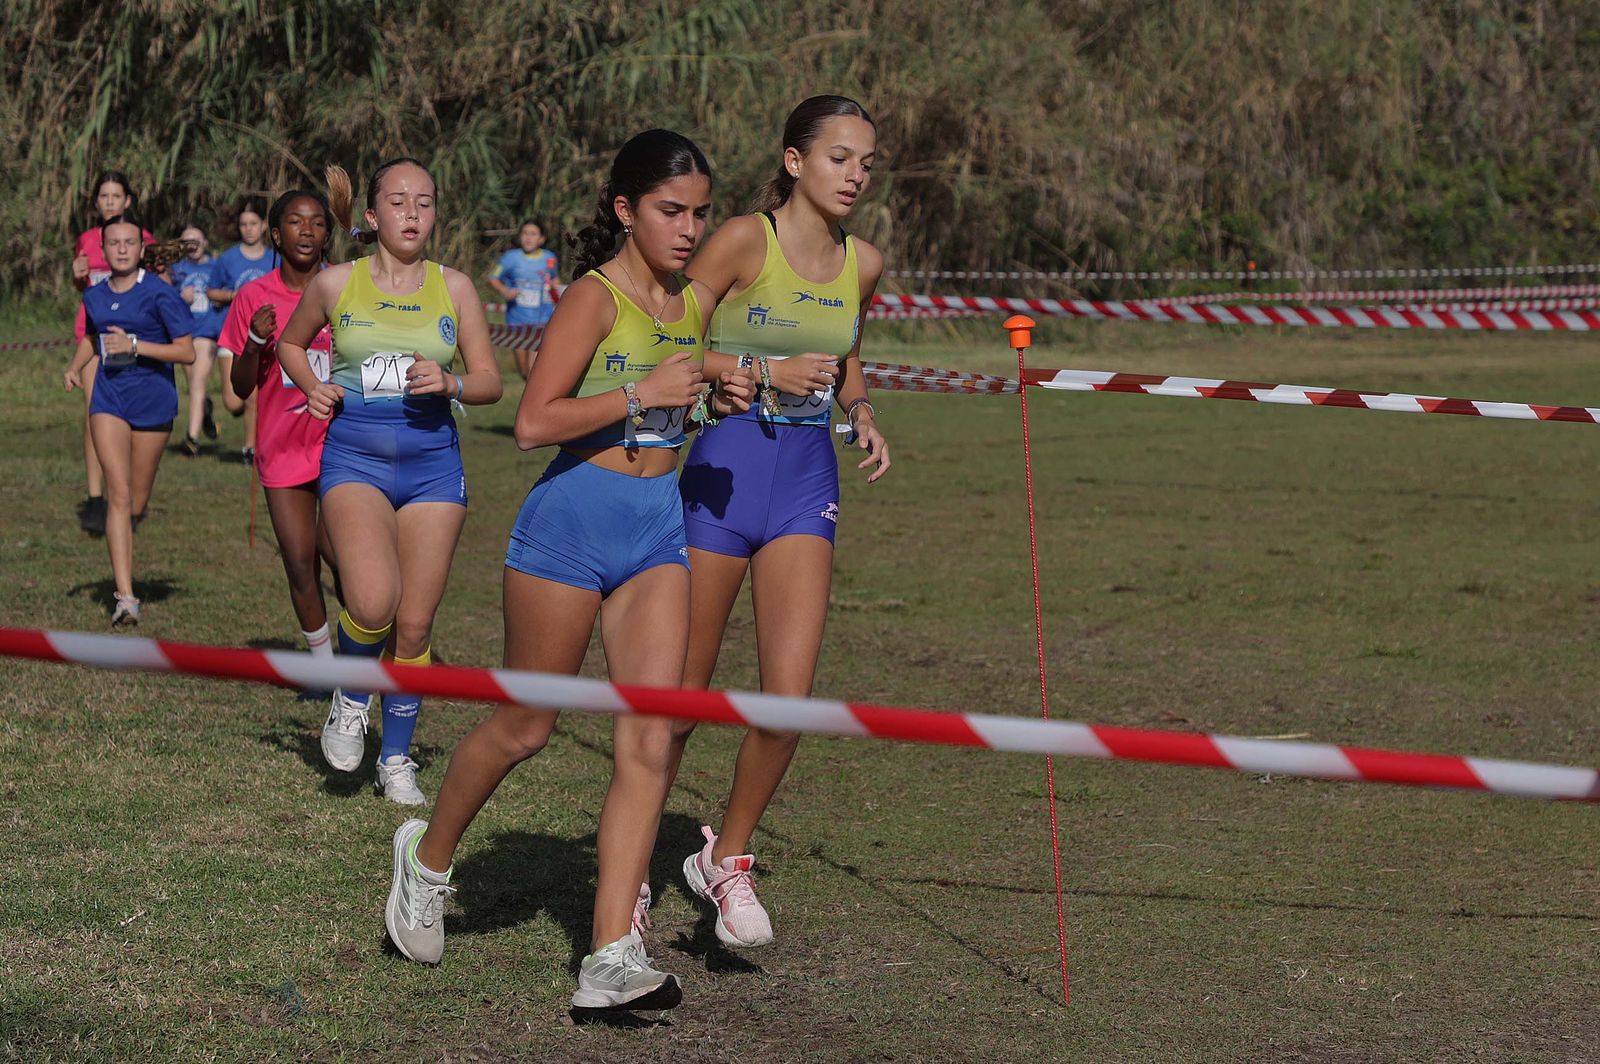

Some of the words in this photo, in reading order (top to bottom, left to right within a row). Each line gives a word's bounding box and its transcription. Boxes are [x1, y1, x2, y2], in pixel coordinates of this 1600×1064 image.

[398, 303, 421, 312] rasán
[818, 297, 844, 308] rasán
[674, 335, 697, 345] rasán
